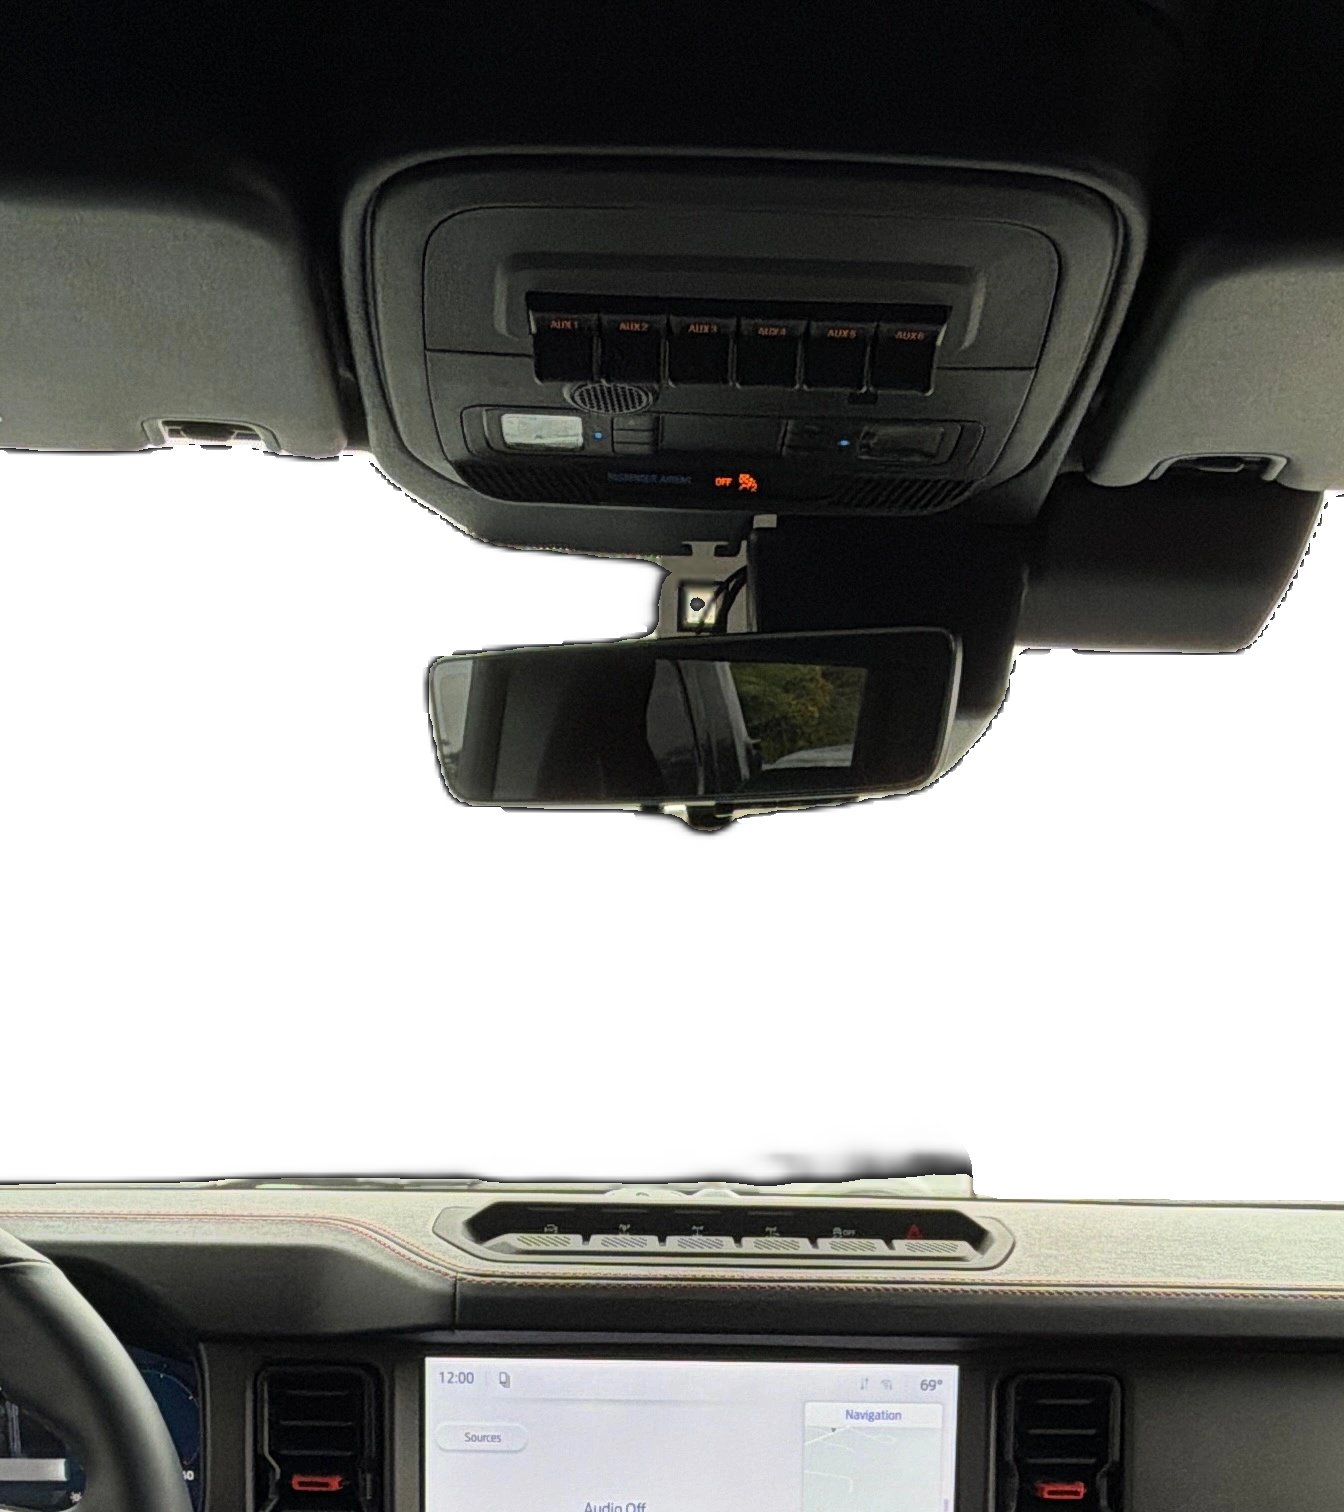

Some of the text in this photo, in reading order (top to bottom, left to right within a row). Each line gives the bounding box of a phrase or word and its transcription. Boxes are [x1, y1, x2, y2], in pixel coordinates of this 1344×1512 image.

[715, 477, 733, 486] OFF
[439, 1371, 475, 1384] 12:00
[845, 1408, 903, 1422] Navigation
[464, 1431, 502, 1443] Sources
